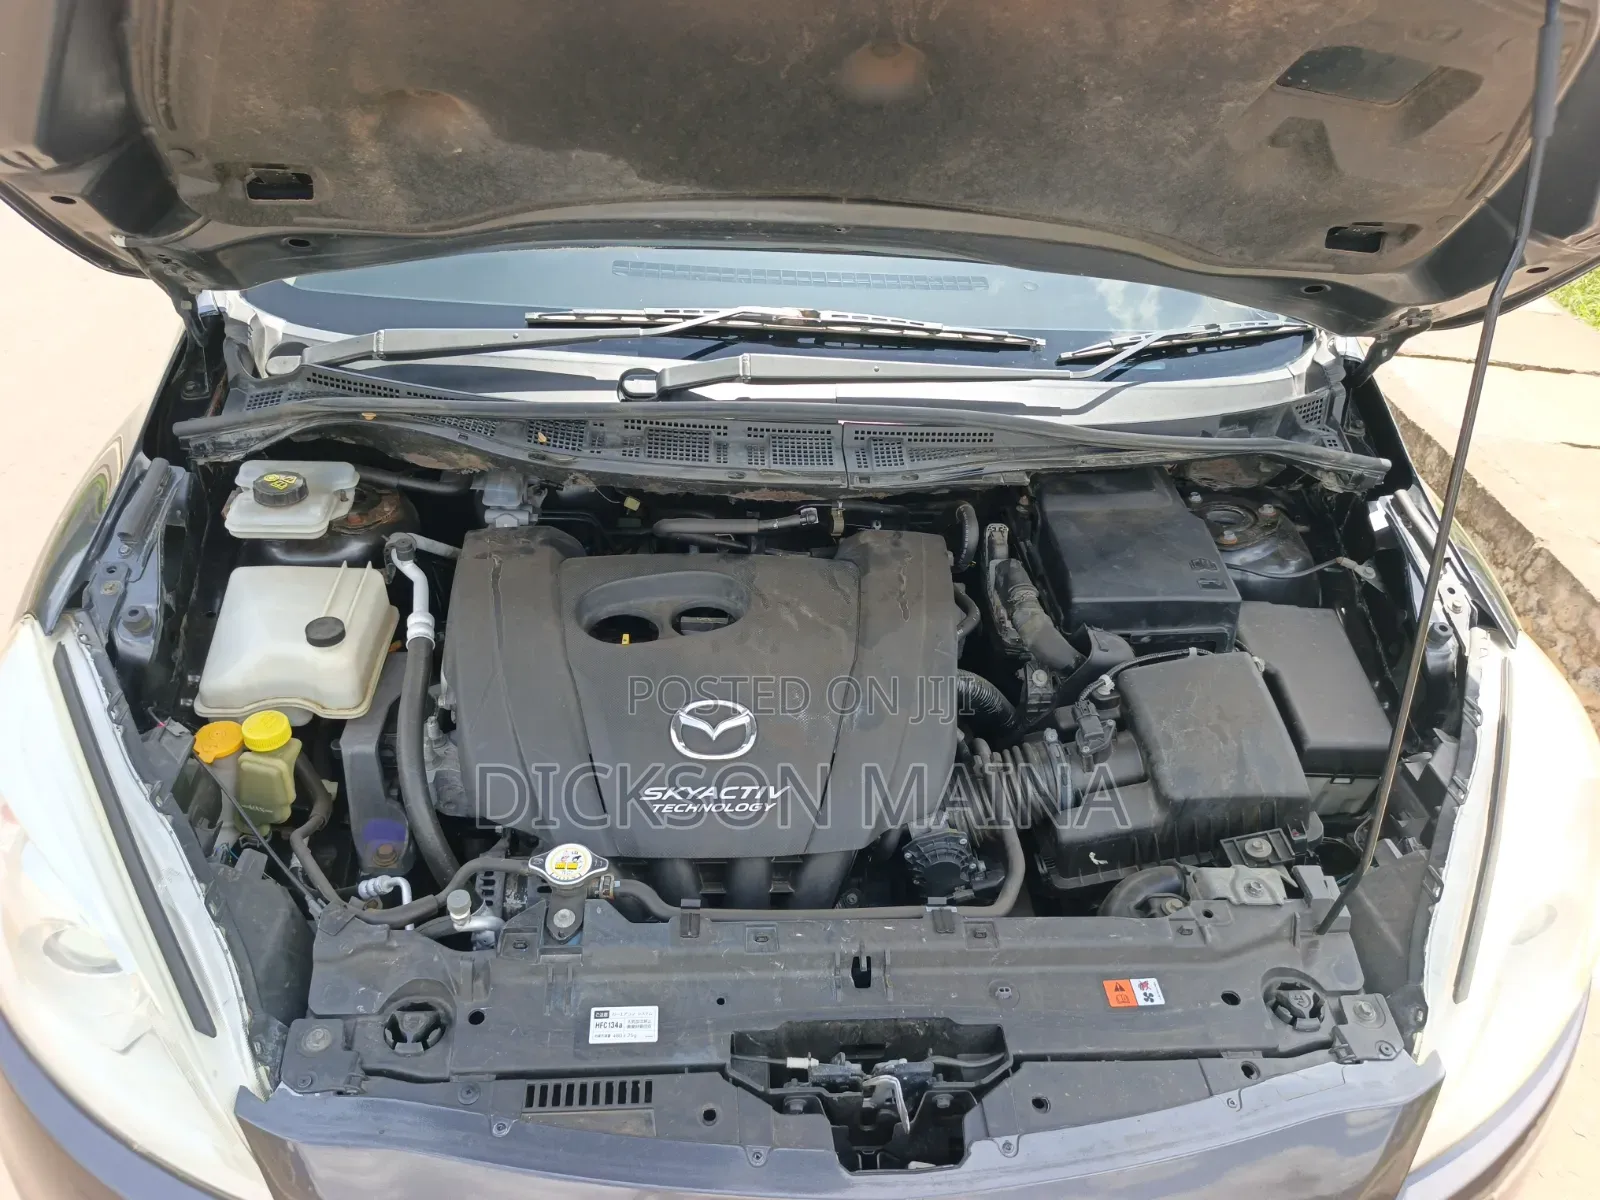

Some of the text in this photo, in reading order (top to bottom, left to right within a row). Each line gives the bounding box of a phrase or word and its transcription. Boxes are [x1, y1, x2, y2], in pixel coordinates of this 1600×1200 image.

[640, 785, 791, 801] SKYACTIV
[652, 802, 776, 813] TECHNOLOGY
[594, 1021, 623, 1029] HFC134a
